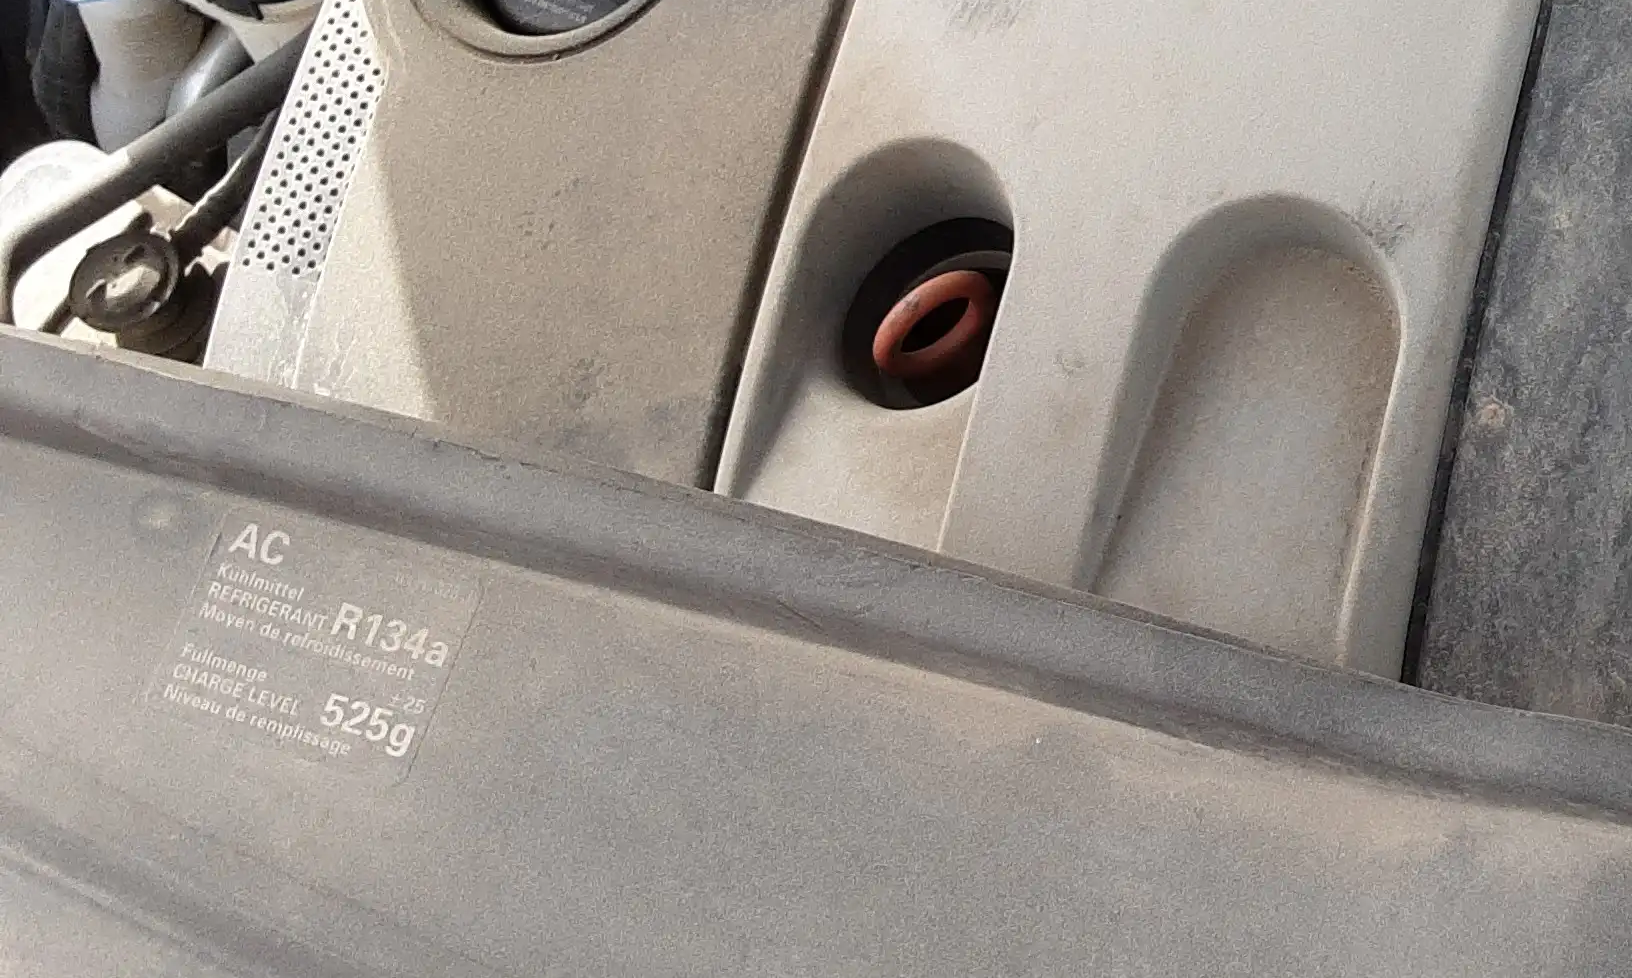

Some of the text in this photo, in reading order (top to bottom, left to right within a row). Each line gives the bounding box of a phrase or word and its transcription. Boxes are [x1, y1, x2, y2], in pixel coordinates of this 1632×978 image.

[228, 523, 290, 565] AC
[199, 603, 415, 681] Moyen de refroidissement
[207, 581, 328, 629] REFRIGERANT
[330, 602, 449, 667] R134a
[164, 683, 351, 756] Niveau de remplissage
[172, 663, 299, 717] CHARGE LEVEL
[320, 693, 415, 757] 525g
